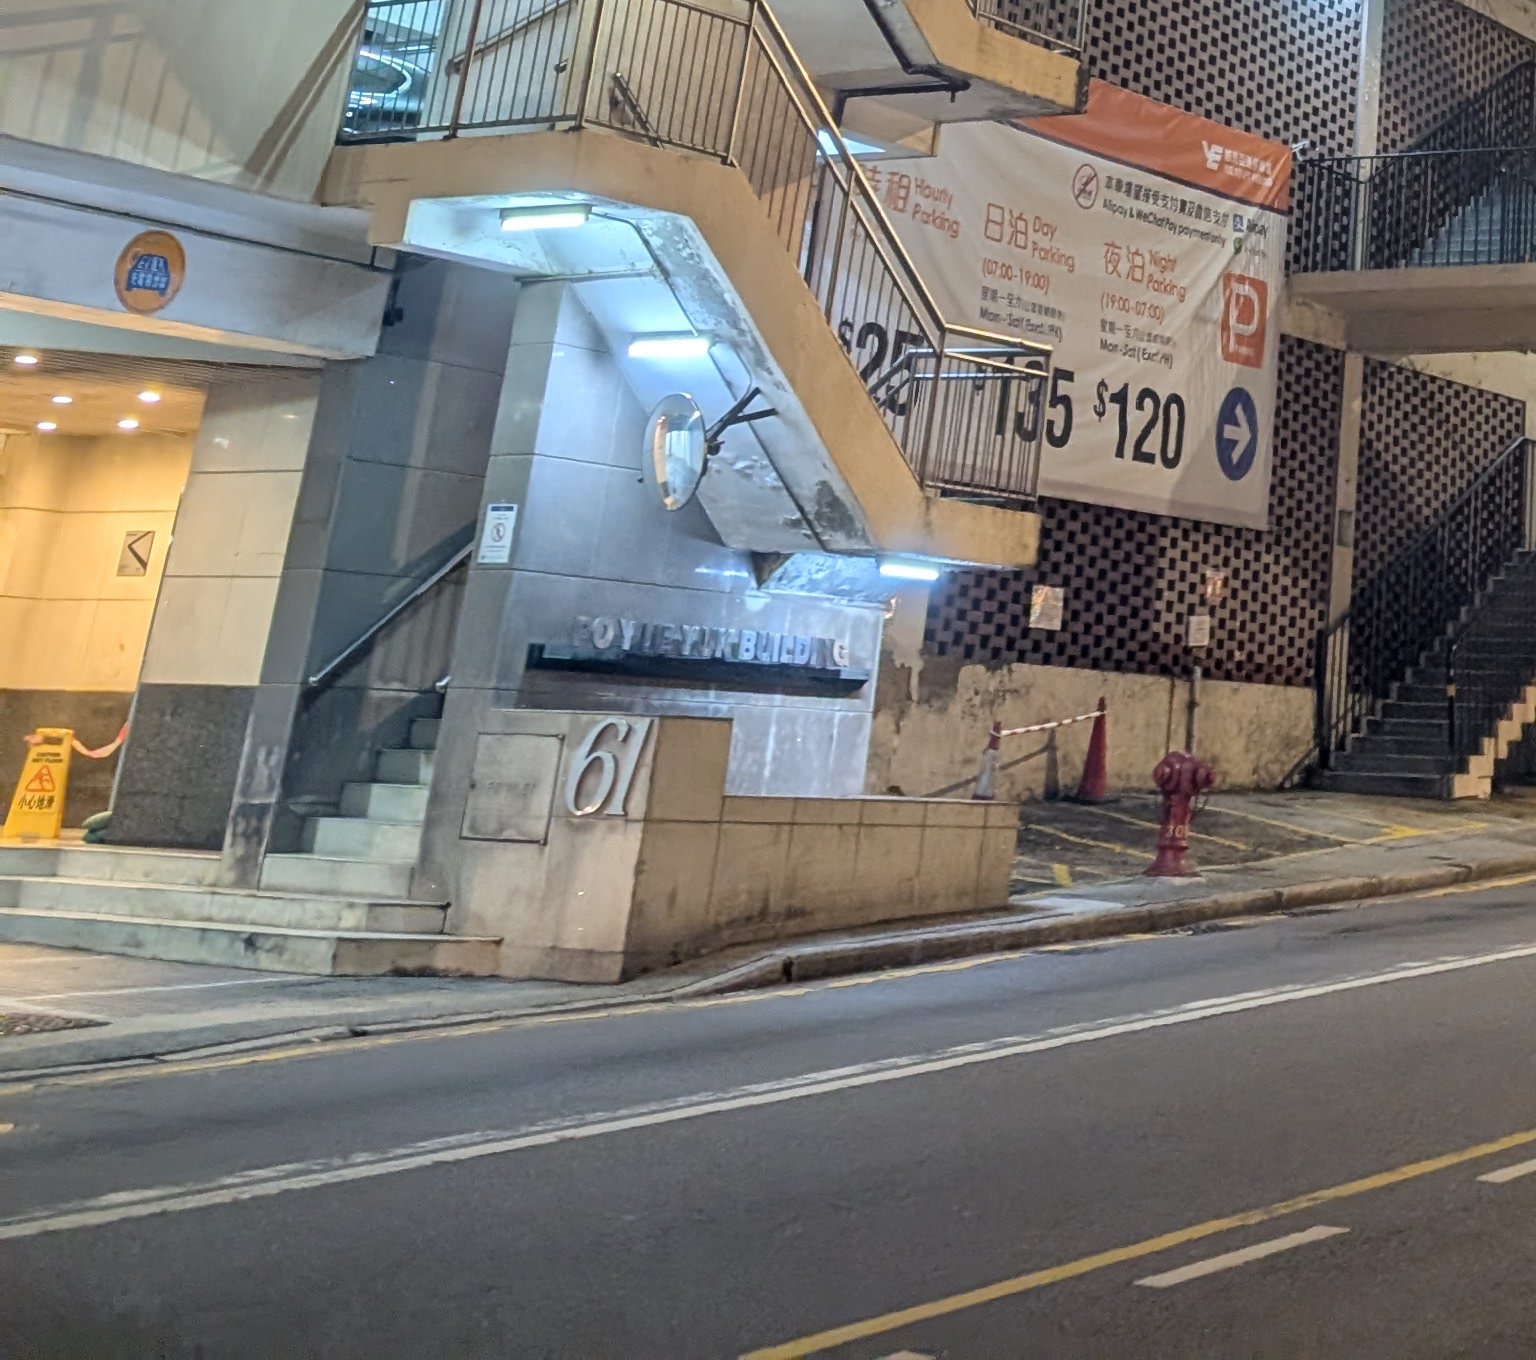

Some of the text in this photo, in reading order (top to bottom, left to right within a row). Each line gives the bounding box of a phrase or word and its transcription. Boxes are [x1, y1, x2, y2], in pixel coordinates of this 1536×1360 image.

[914, 177, 953, 207] Hourly
[1103, 198, 1127, 218] Alipay
[912, 203, 960, 239] Parking
[985, 203, 1028, 249] 日泊
[1033, 216, 1057, 242] Day
[1032, 241, 1075, 273] Parking
[1104, 240, 1146, 283] 夜泊
[1149, 249, 1177, 274] Night
[1146, 273, 1188, 303] Parking
[1093, 379, 1186, 470] $120
[738, 630, 848, 668] BUILDING
[565, 717, 653, 817] 61
[19, 795, 55, 810] 小心地滑
